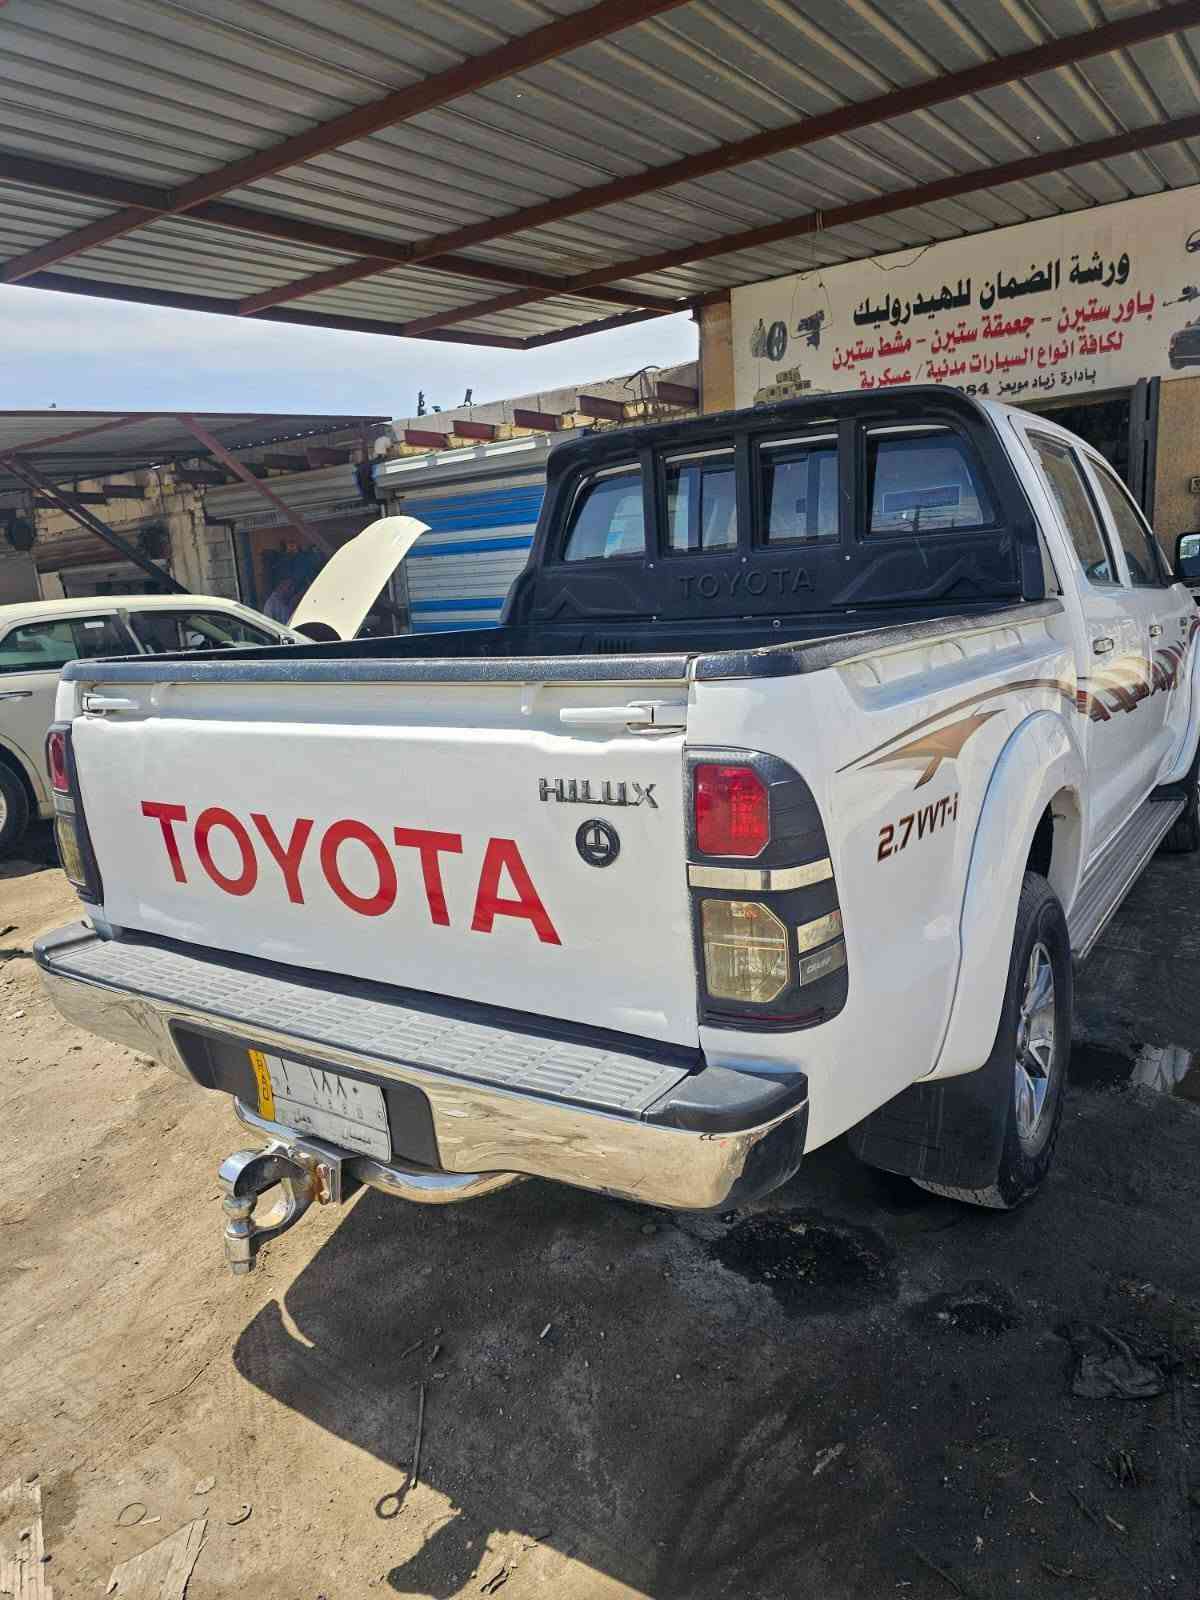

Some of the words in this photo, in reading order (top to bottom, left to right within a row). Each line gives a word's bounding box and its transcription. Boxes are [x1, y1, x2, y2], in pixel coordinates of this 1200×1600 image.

[979, 257, 1061, 310] الضمان
[1069, 251, 1130, 287] ورشة
[853, 277, 971, 329] للهيدروليك
[878, 330, 912, 356] مشط
[931, 321, 978, 354] ستيرن
[1080, 330, 1123, 356] لكافة
[832, 339, 874, 370] ستيرن
[926, 358, 966, 382] مدنية
[969, 344, 1034, 374] السيارات
[860, 367, 912, 388] عسكرية
[678, 567, 816, 601] TOYOTA
[538, 777, 659, 809] HILUX
[140, 800, 562, 946] TOYOTA
